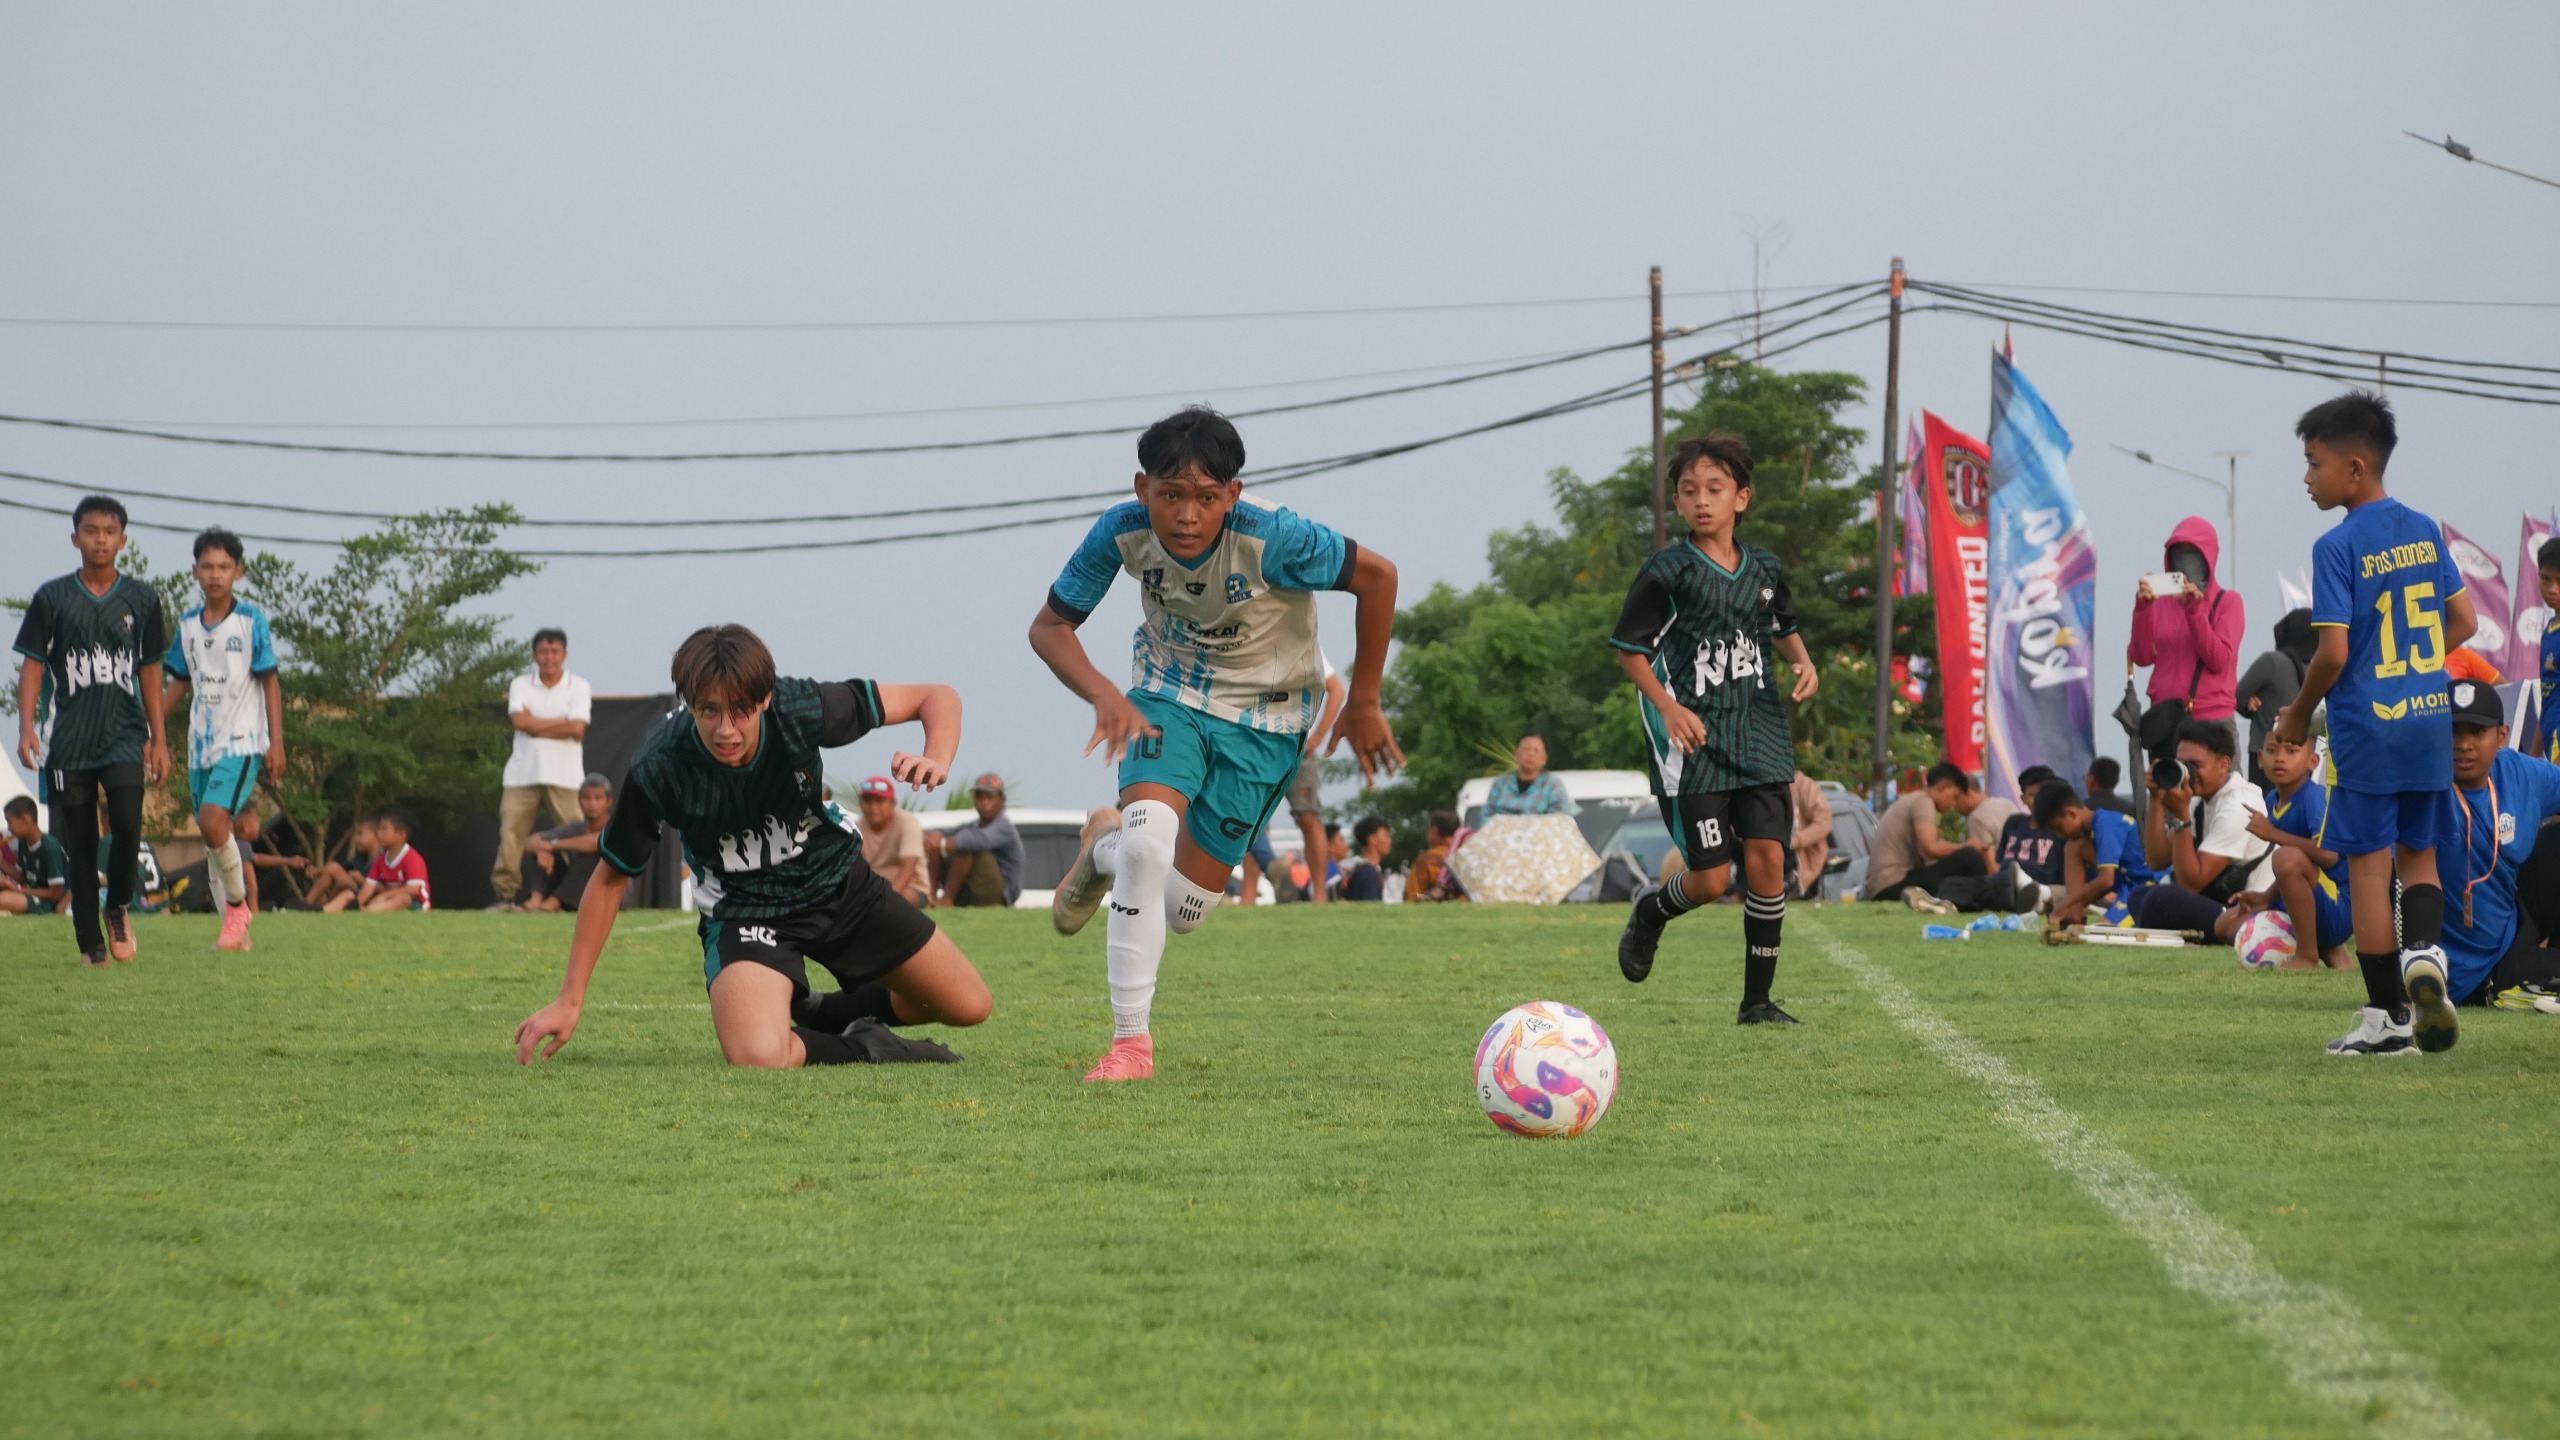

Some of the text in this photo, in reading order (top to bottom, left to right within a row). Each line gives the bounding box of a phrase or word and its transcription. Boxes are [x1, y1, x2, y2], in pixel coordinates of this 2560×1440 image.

[1956, 535, 1988, 659] UNITED
[2374, 582, 2446, 679] 15
[65, 641, 135, 697] NBG
[53, 768, 65, 792] 11
[1696, 817, 1723, 849] 18
